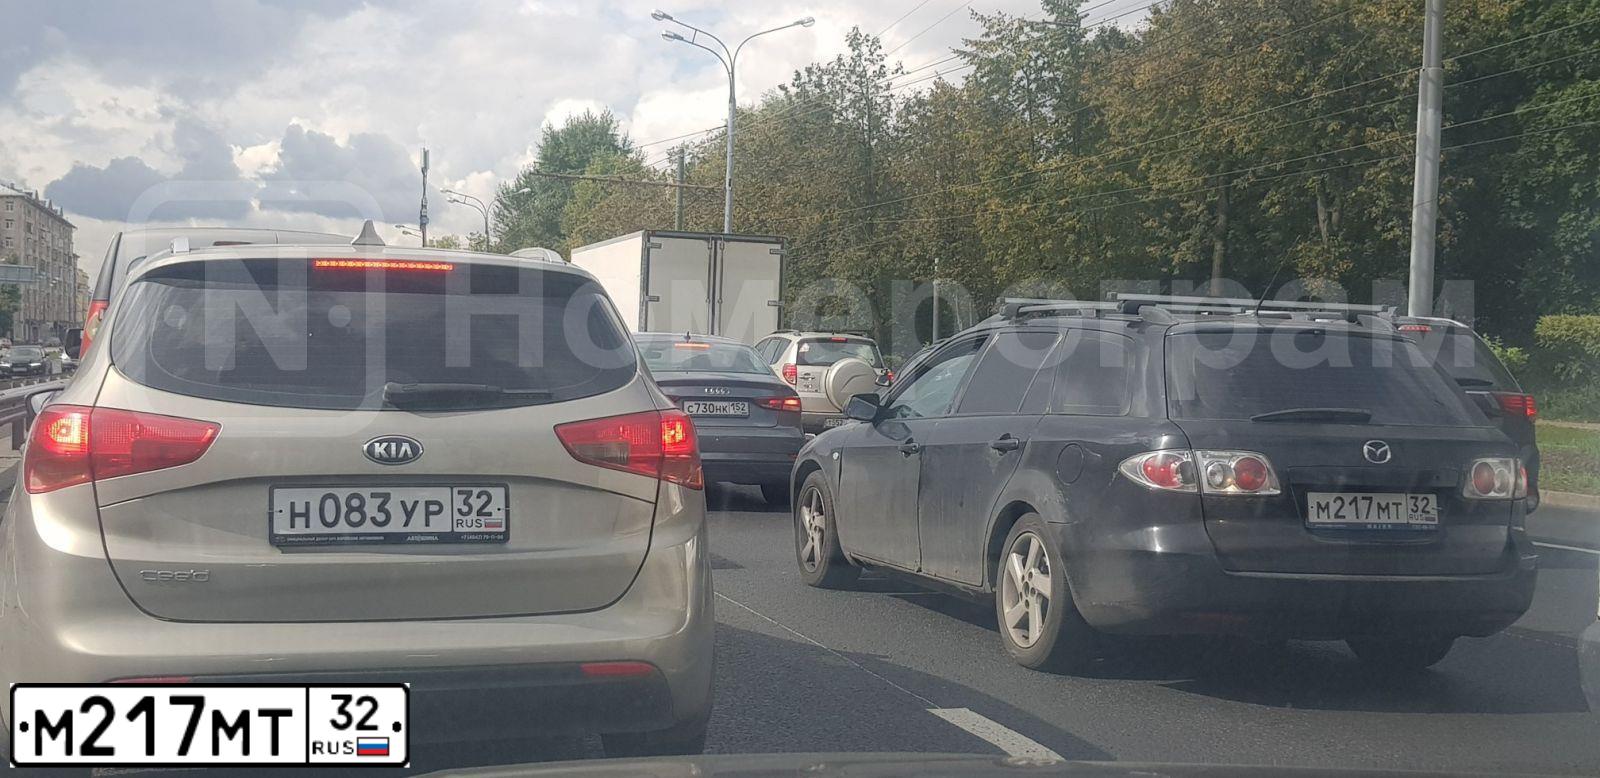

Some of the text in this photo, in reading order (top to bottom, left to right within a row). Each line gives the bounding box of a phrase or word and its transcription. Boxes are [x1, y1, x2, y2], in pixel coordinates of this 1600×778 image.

[687, 402, 746, 414] С730НК 152
[373, 442, 414, 459] KIA
[289, 489, 493, 529] Н083УР 32
[1315, 495, 1431, 520] М217МТ 32
[455, 518, 483, 529] RUS
